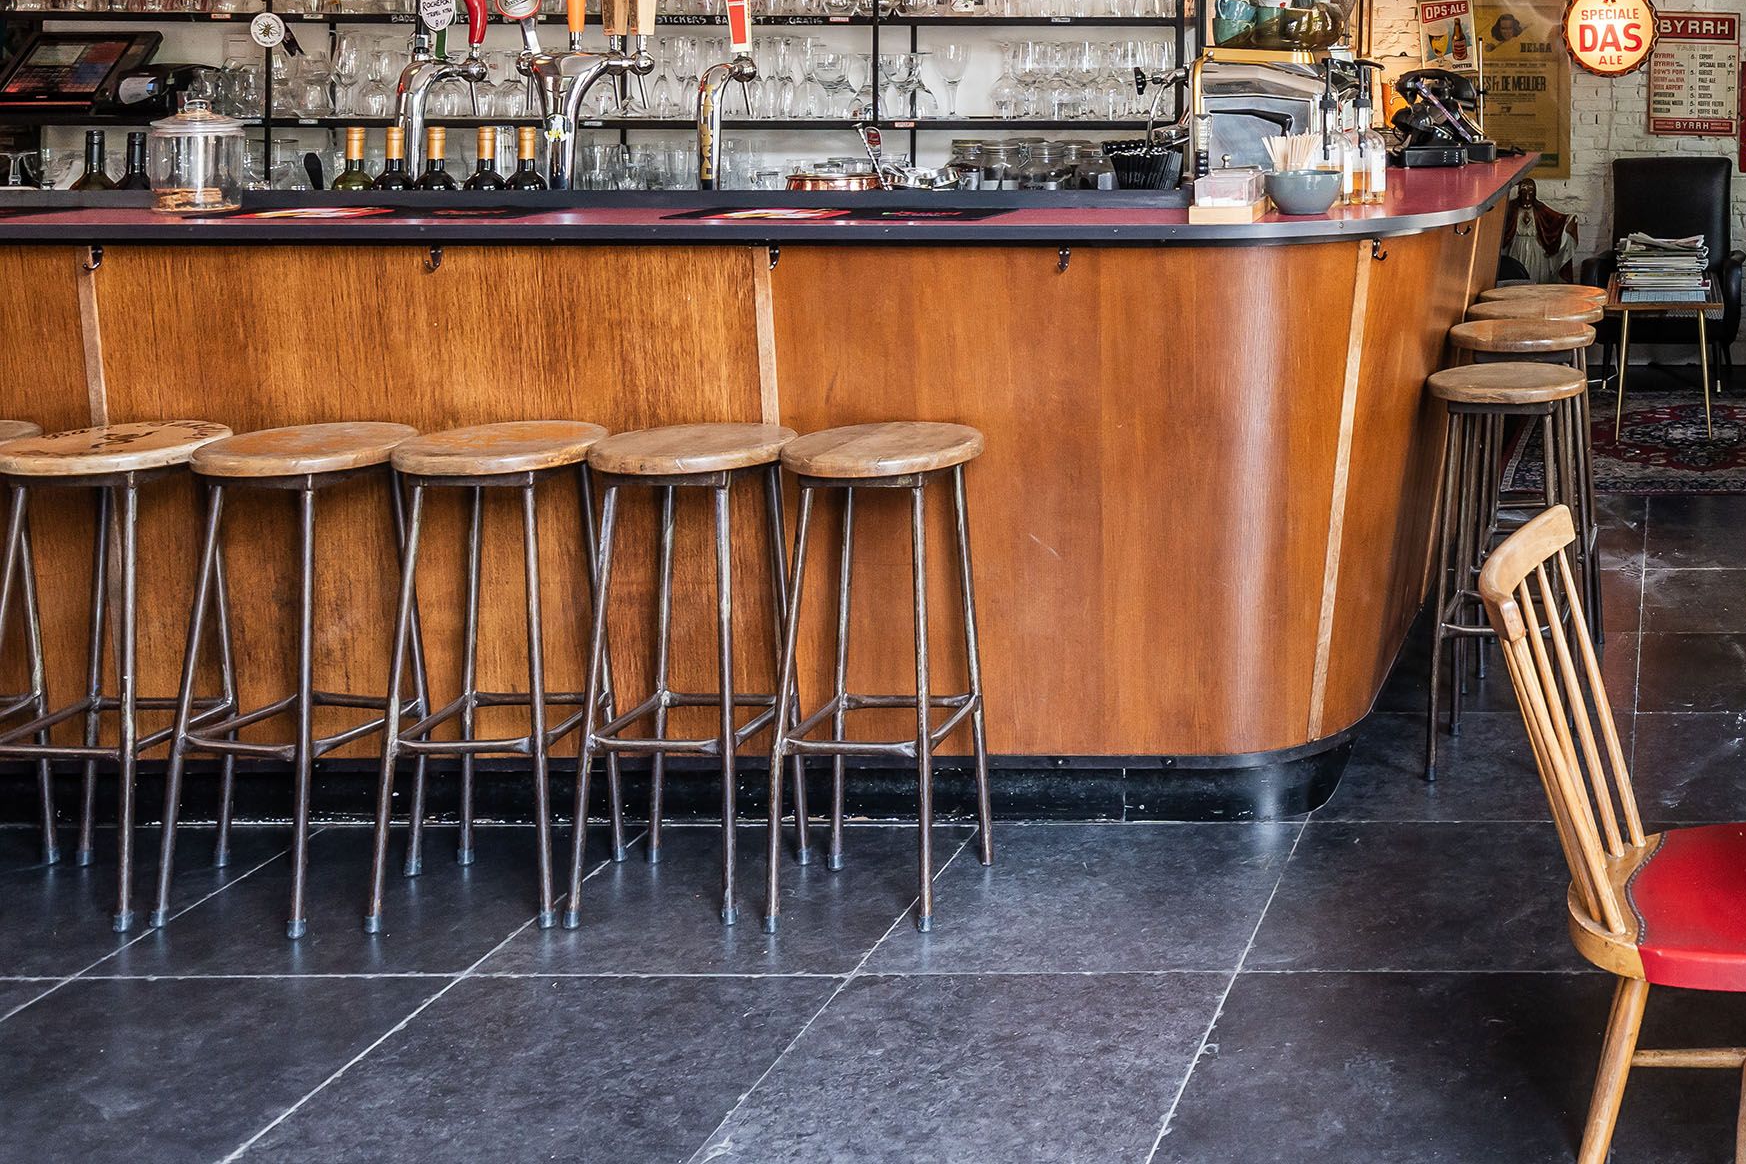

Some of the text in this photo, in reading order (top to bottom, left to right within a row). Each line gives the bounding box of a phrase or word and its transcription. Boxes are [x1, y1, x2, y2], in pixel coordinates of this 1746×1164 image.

[1581, 8, 1640, 22] SPECIALE
[1660, 19, 1729, 35] BYRRH
[1578, 24, 1643, 53] DAS
[1599, 54, 1623, 66] ALE
[1675, 121, 1709, 130] BYRRH
